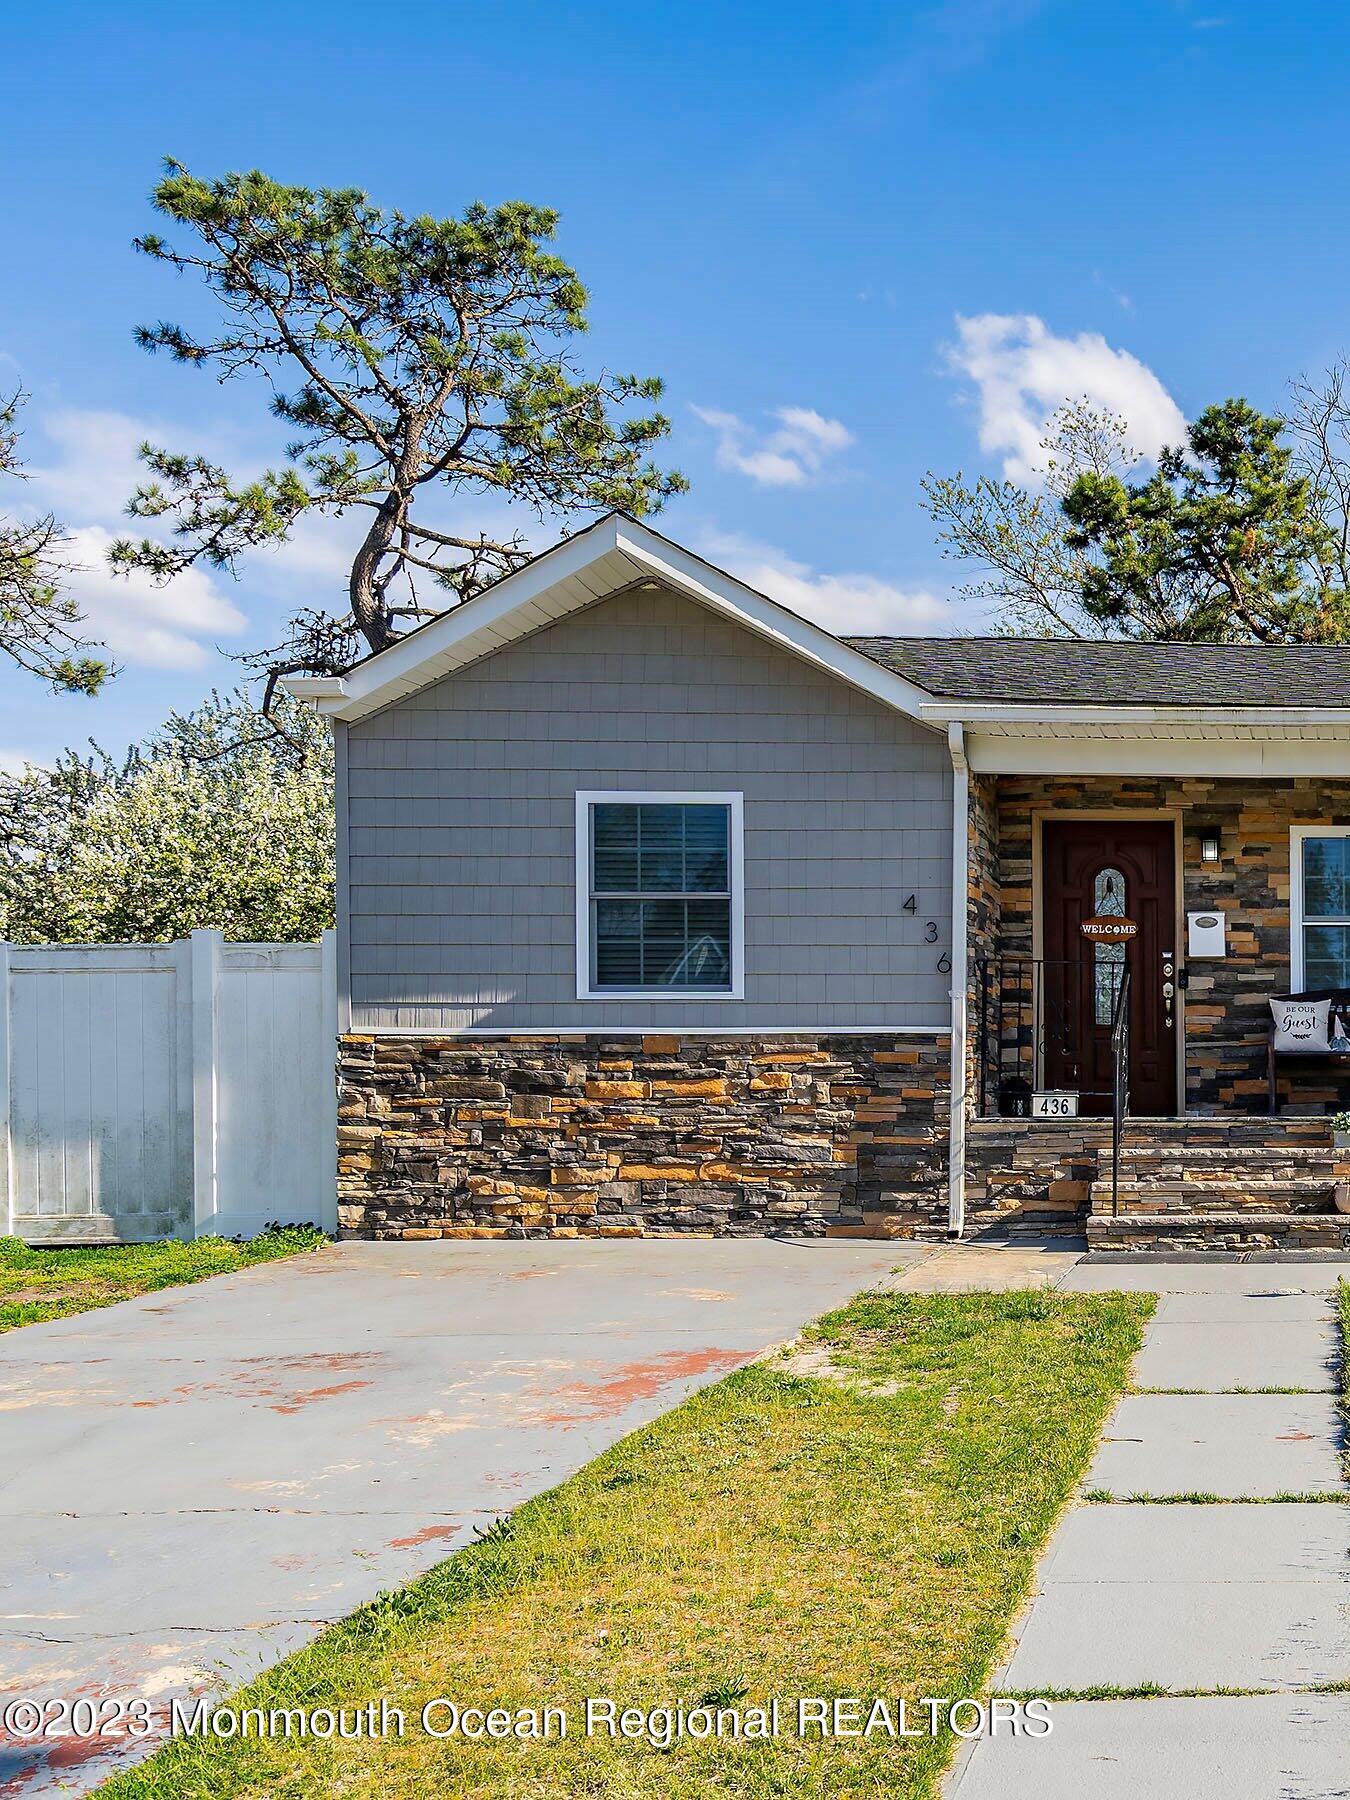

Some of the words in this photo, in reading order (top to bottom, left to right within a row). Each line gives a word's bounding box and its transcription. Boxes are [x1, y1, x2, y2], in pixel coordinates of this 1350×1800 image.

[1082, 924, 1137, 935] WELCOME
[1282, 1014, 1320, 1033] Guest
[1040, 1098, 1069, 1115] 436
